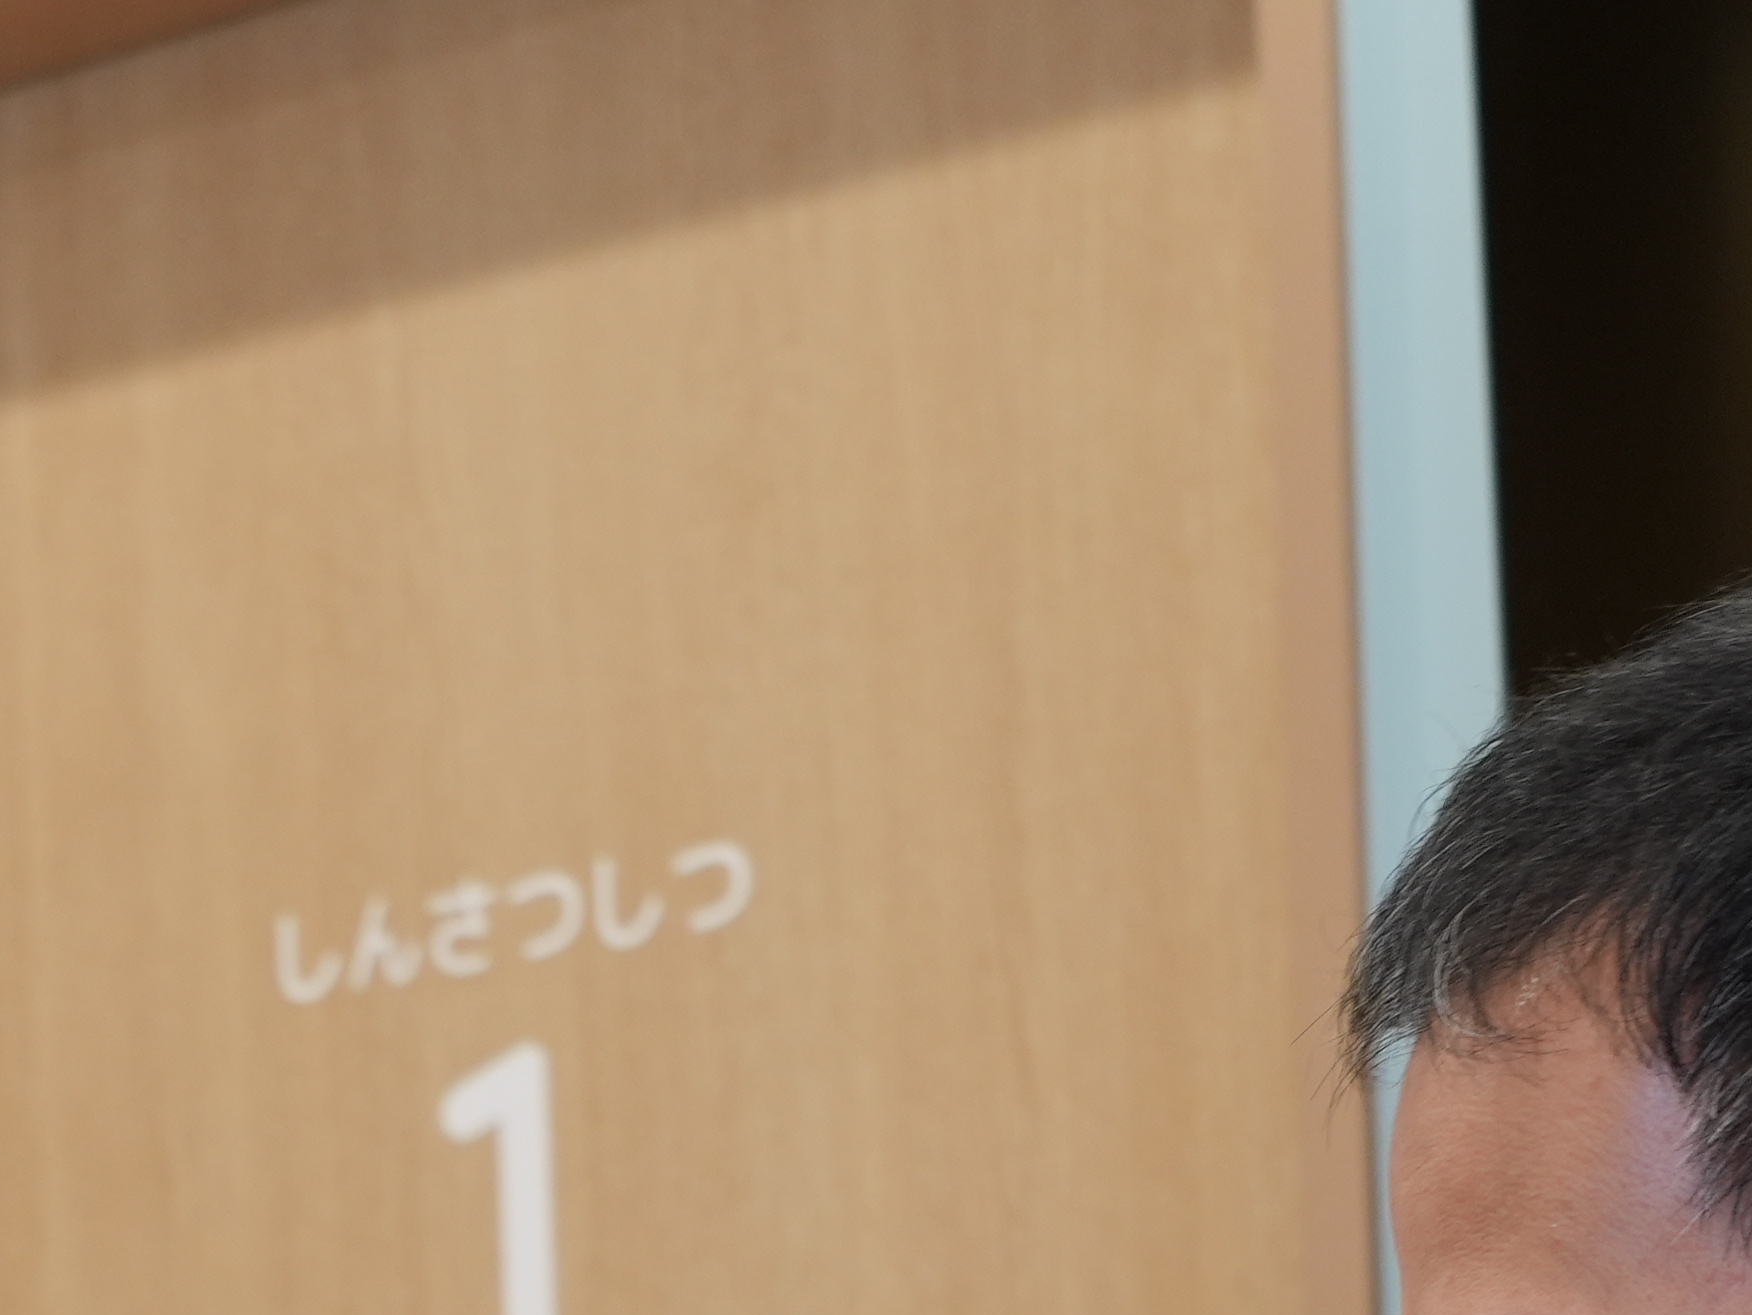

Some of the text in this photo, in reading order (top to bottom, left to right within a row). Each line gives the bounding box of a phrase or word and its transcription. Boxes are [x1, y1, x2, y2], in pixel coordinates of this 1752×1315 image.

[274, 838, 755, 1004] しんさつしつ
